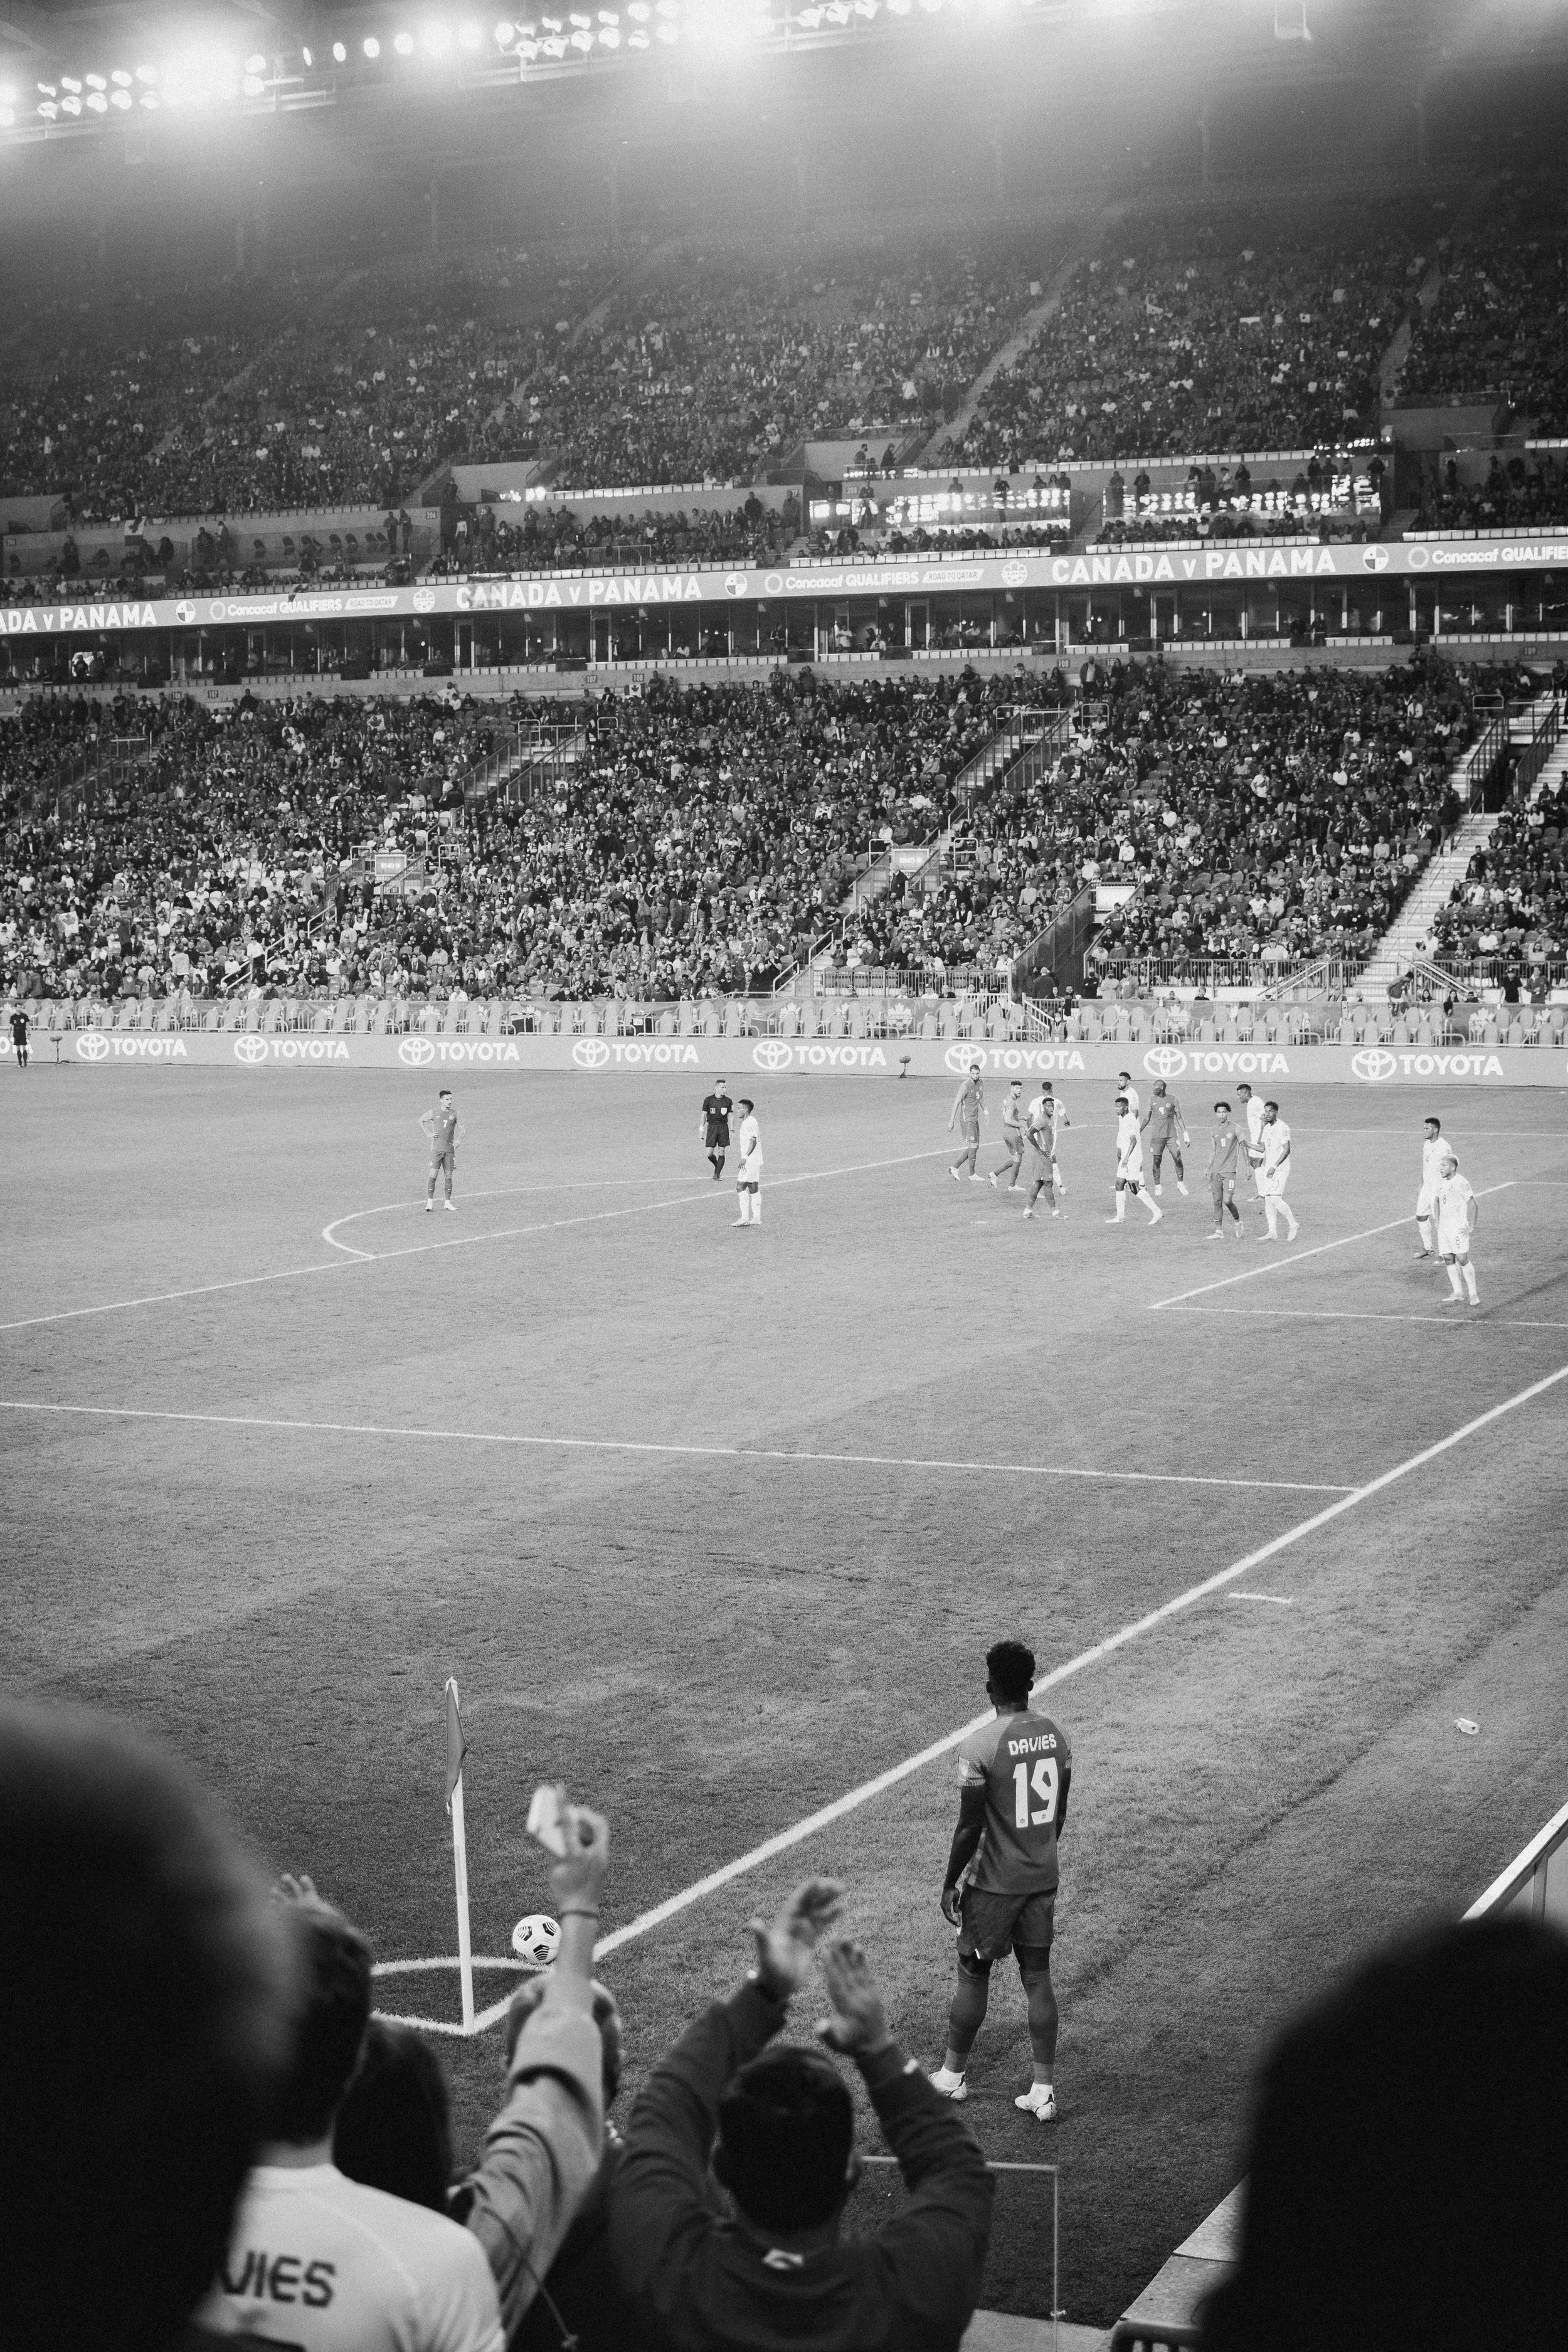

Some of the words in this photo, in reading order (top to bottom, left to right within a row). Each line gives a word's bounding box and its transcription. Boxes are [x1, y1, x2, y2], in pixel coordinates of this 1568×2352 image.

[1052, 555, 1174, 583] CANADA
[1182, 559, 1197, 576] v
[1205, 548, 1336, 576] PANAMA
[1432, 548, 1498, 564] Concacaf
[1501, 546, 1568, 562] QUALIFIE
[785, 575, 844, 590] Concacaf
[846, 570, 919, 586] QUALIFIERS
[455, 582, 562, 609] CANADA
[569, 587, 581, 604] v
[588, 576, 702, 603] PANAMA
[43, 613, 54, 630] v
[60, 603, 157, 630] PANAMA
[228, 603, 278, 617] Concacaf
[279, 598, 342, 613] QUALIFIERS
[111, 1037, 187, 1056] TOYOTA
[270, 1039, 350, 1059] TOYOTA
[437, 1042, 520, 1061] TOYOTA
[612, 1044, 699, 1063] TOYOTA
[795, 1045, 887, 1066] TOYOTA
[990, 1049, 1085, 1070] TOYOTA
[1190, 1051, 1290, 1073] TOYOTA
[1399, 1054, 1503, 1076] TOYOTA
[443, 1120, 448, 1128] 7
[1008, 1734, 1057, 1756] DAVIES
[1012, 1757, 1059, 1828] 19
